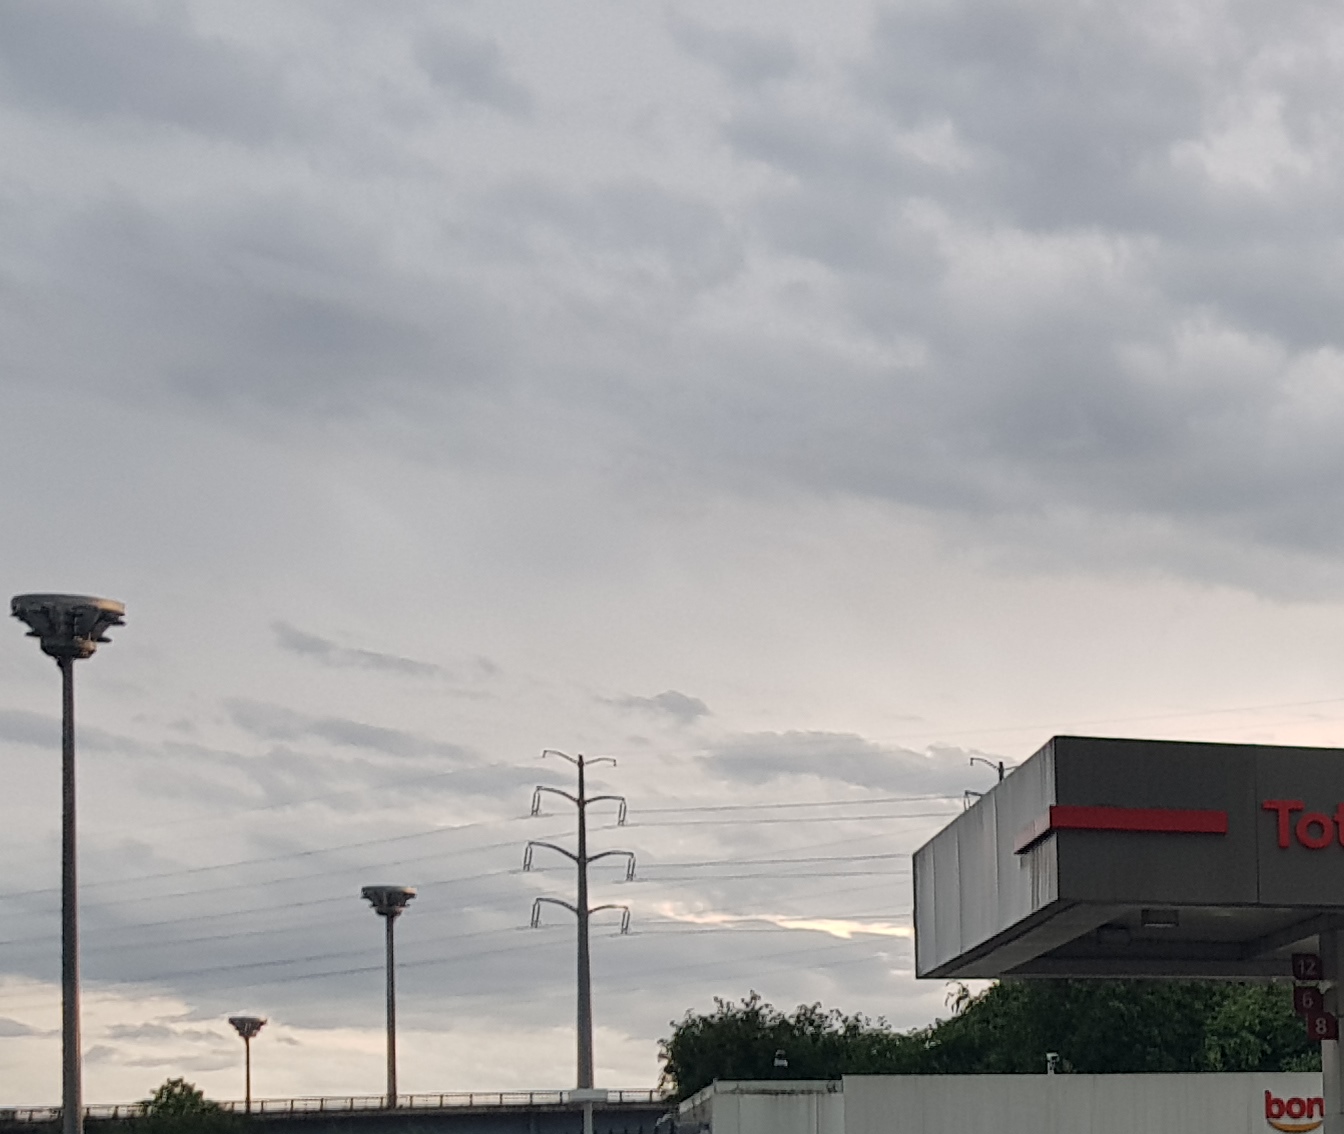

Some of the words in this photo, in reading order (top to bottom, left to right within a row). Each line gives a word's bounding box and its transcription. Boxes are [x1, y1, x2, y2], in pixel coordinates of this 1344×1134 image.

[1298, 958, 1317, 976] 12
[1302, 991, 1313, 1009] 6
[1315, 1016, 1327, 1035] 8
